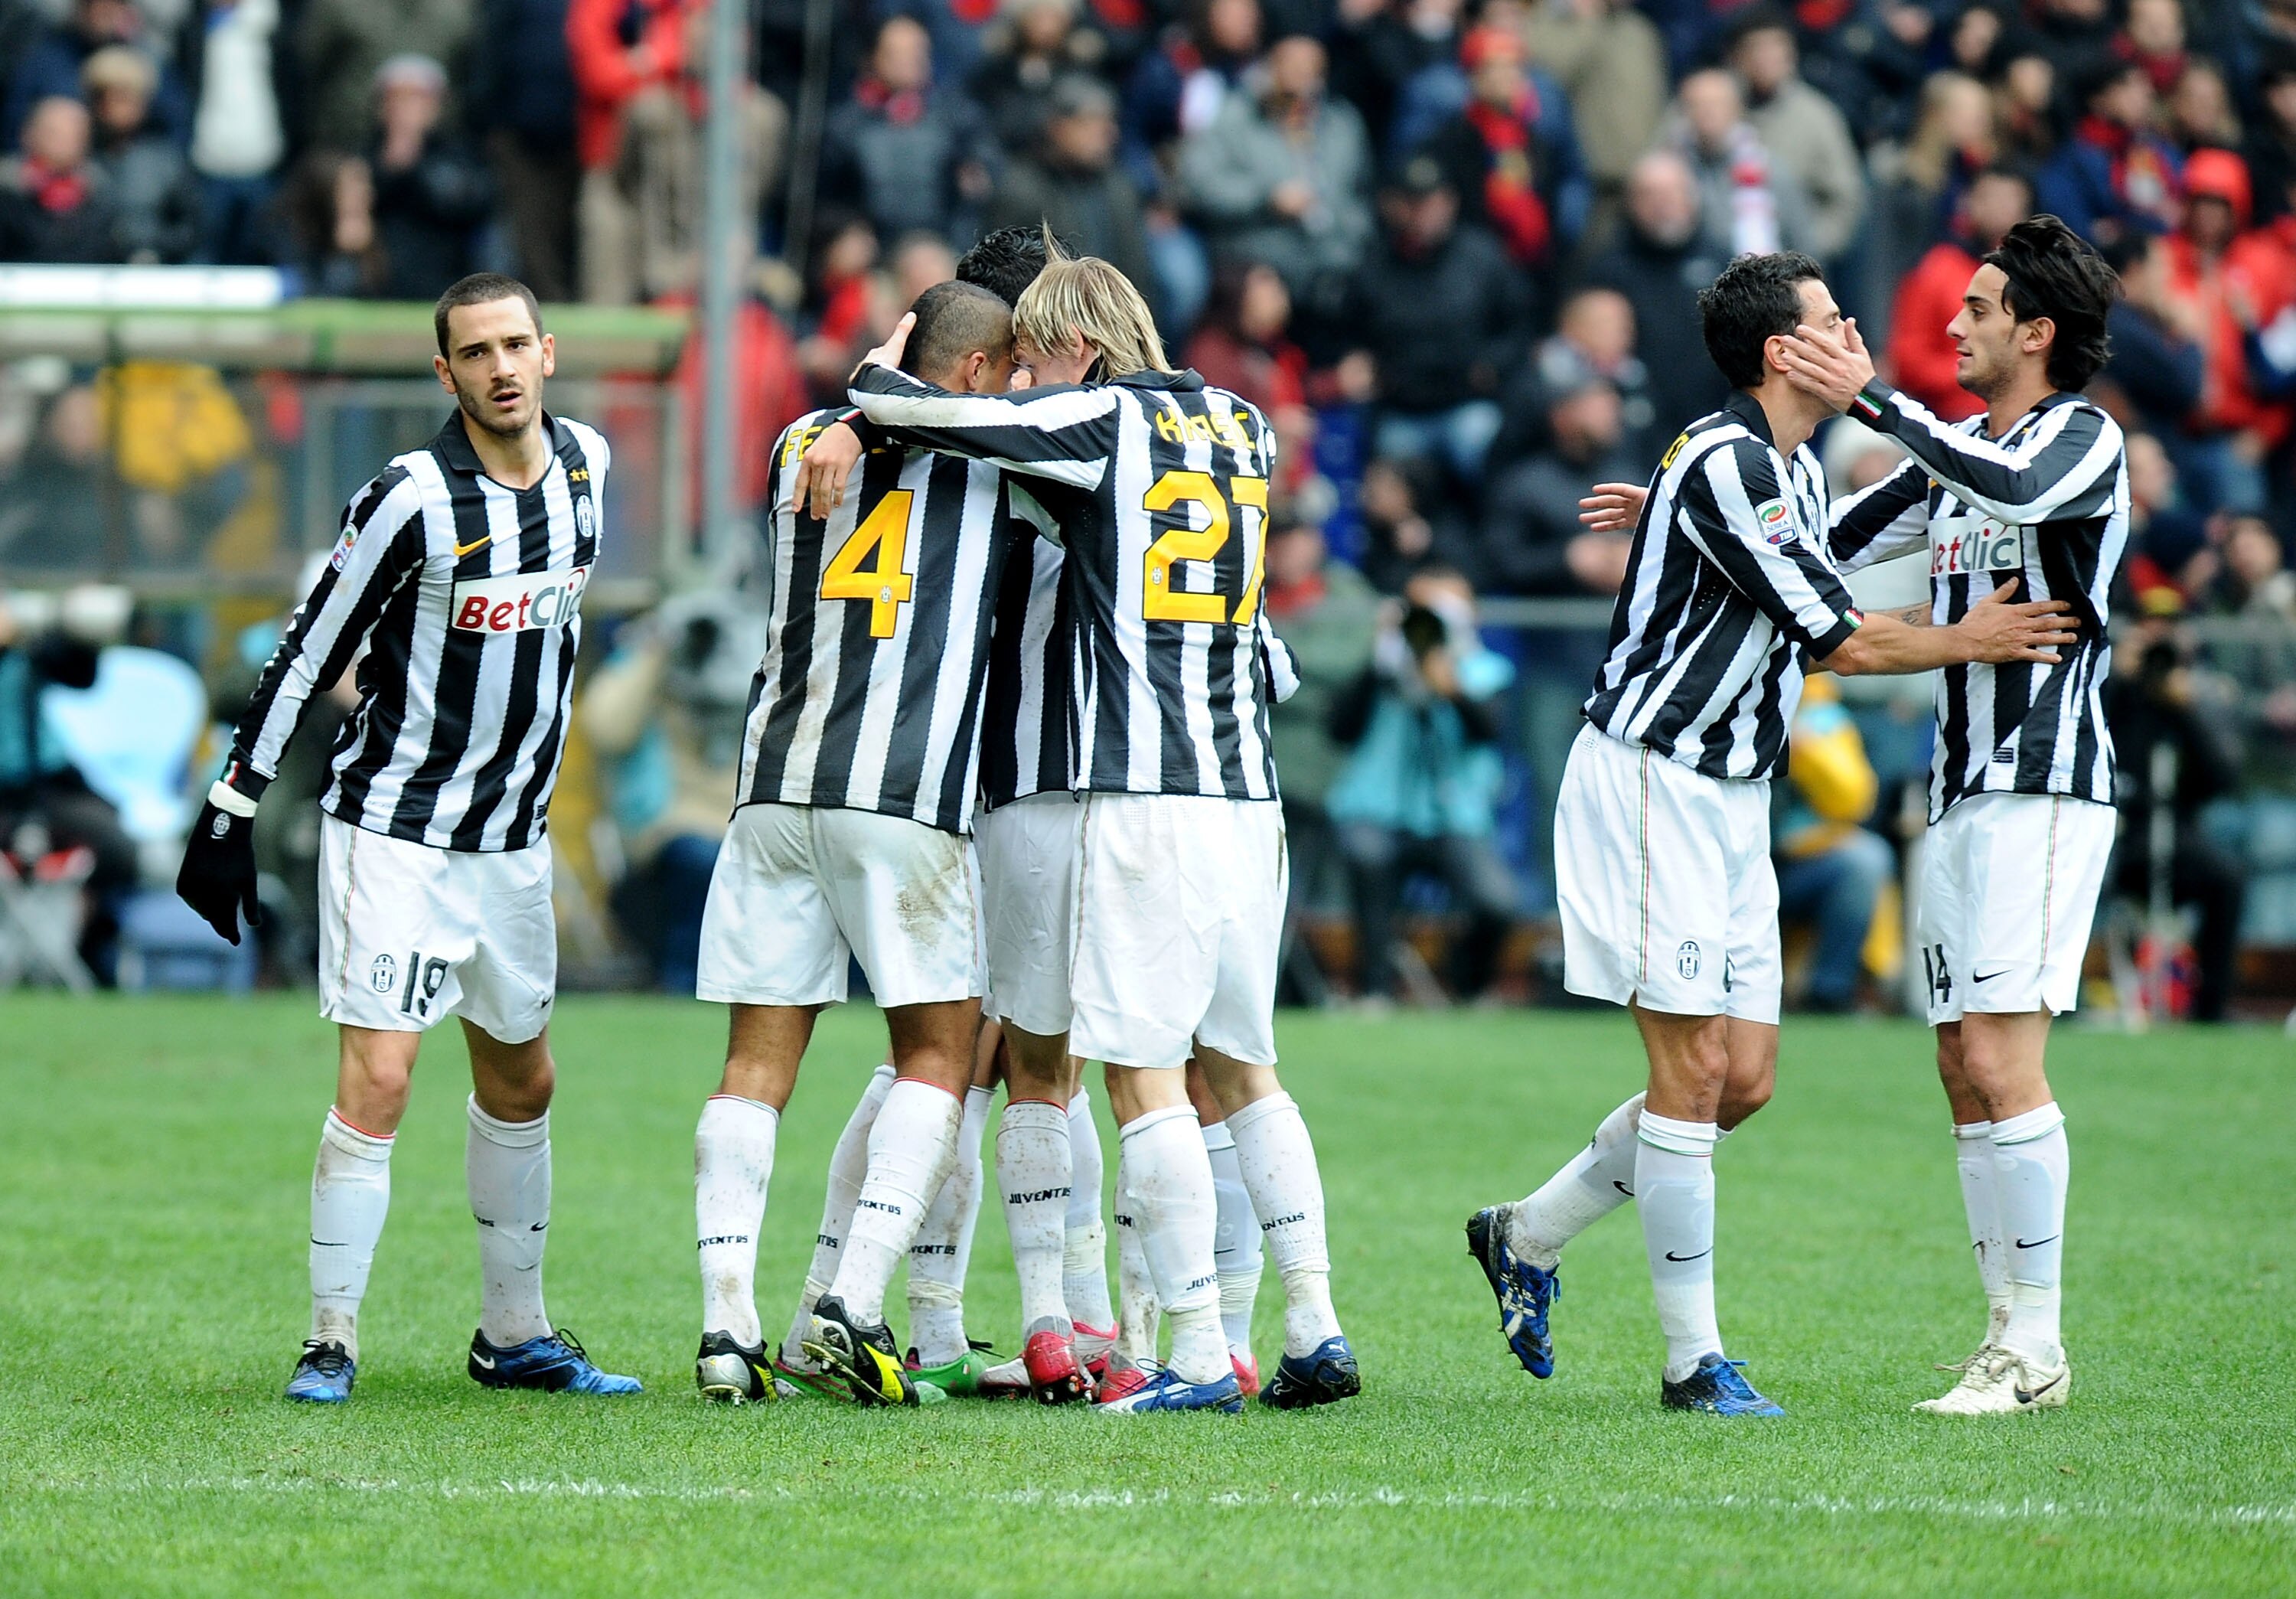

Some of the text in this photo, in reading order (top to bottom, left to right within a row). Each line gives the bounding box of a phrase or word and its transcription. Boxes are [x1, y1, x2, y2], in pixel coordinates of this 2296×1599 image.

[820, 488, 915, 640] 4
[1142, 469, 1270, 626] 27
[400, 950, 448, 1018] 19
[1922, 942, 1952, 1010] 14
